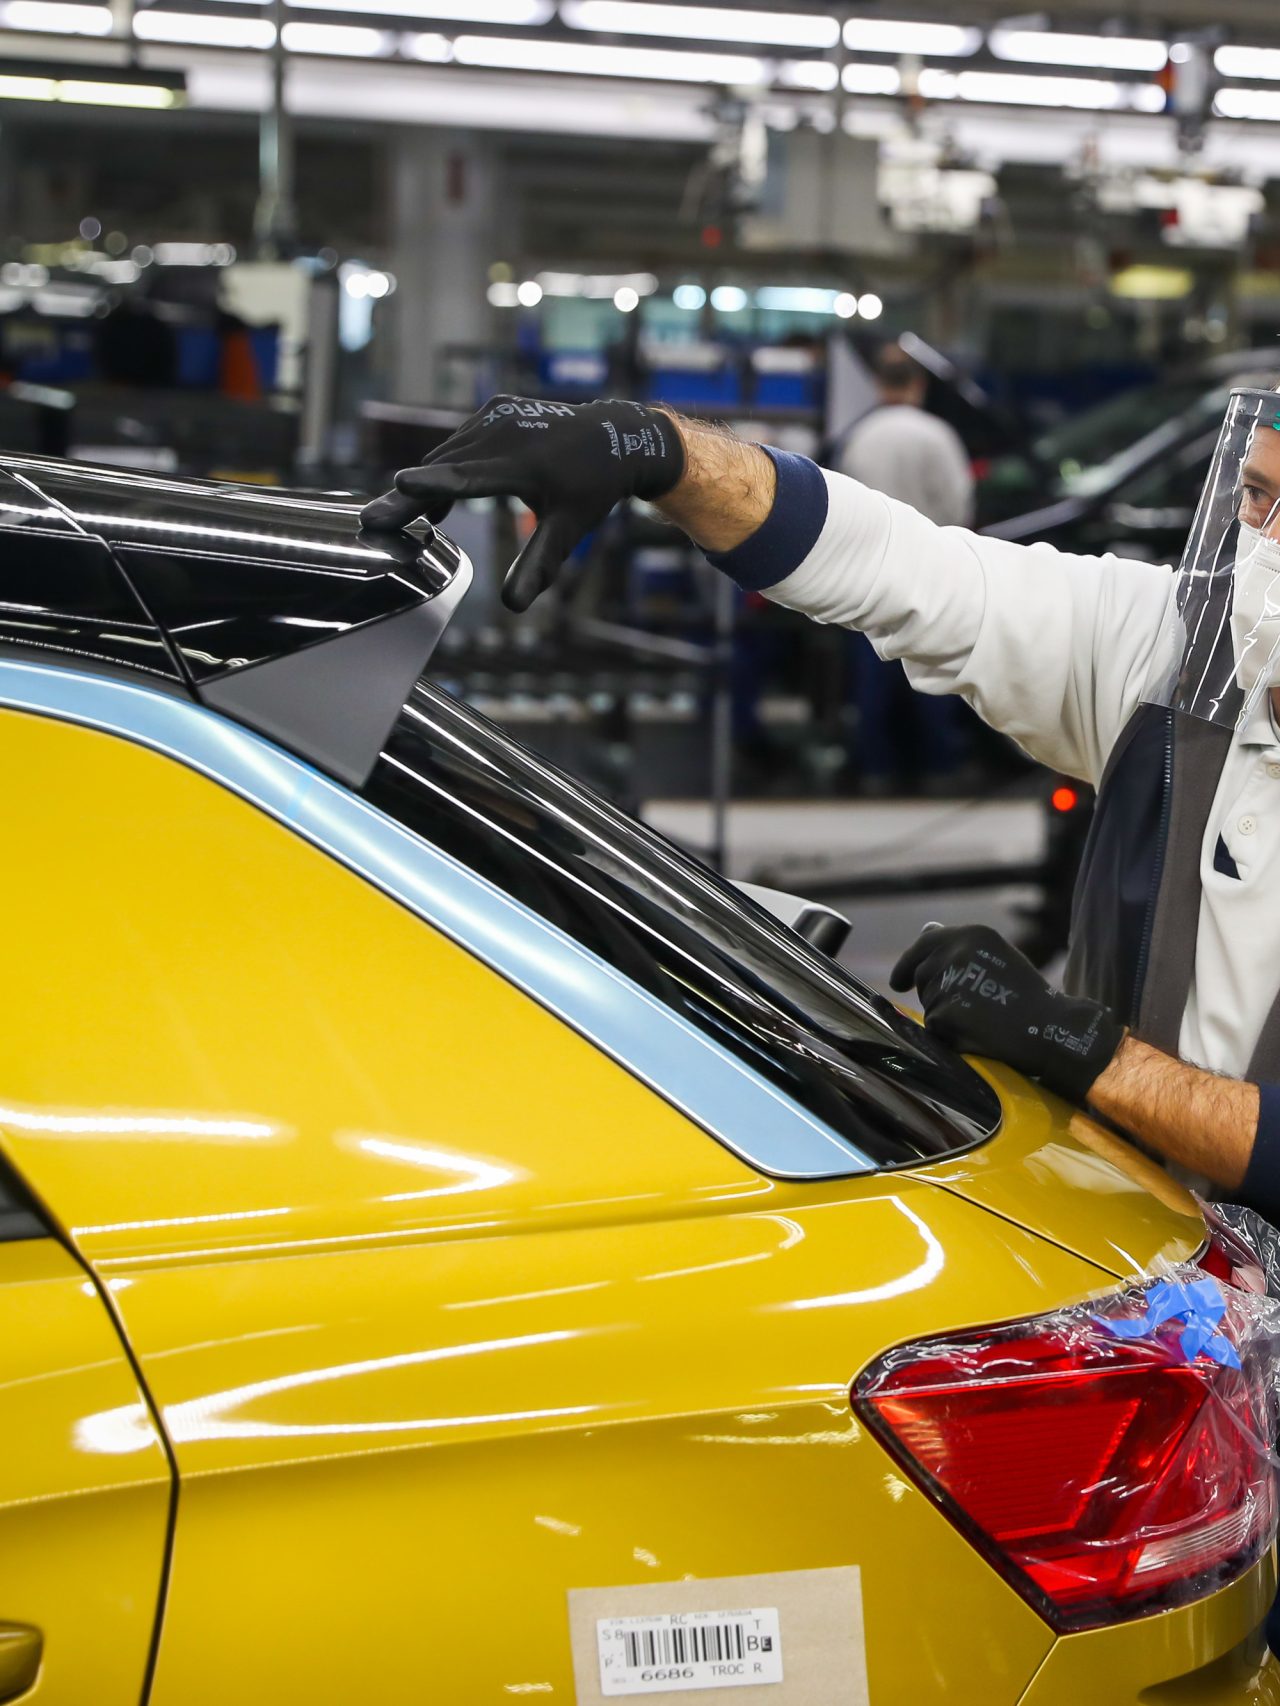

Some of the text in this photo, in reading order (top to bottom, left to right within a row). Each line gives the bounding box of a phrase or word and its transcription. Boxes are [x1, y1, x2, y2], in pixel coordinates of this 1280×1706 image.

[483, 402, 576, 424] HyFlex
[641, 1667, 694, 1682] 6686
[711, 1663, 745, 1676] TROC
[753, 1662, 762, 1673] R
